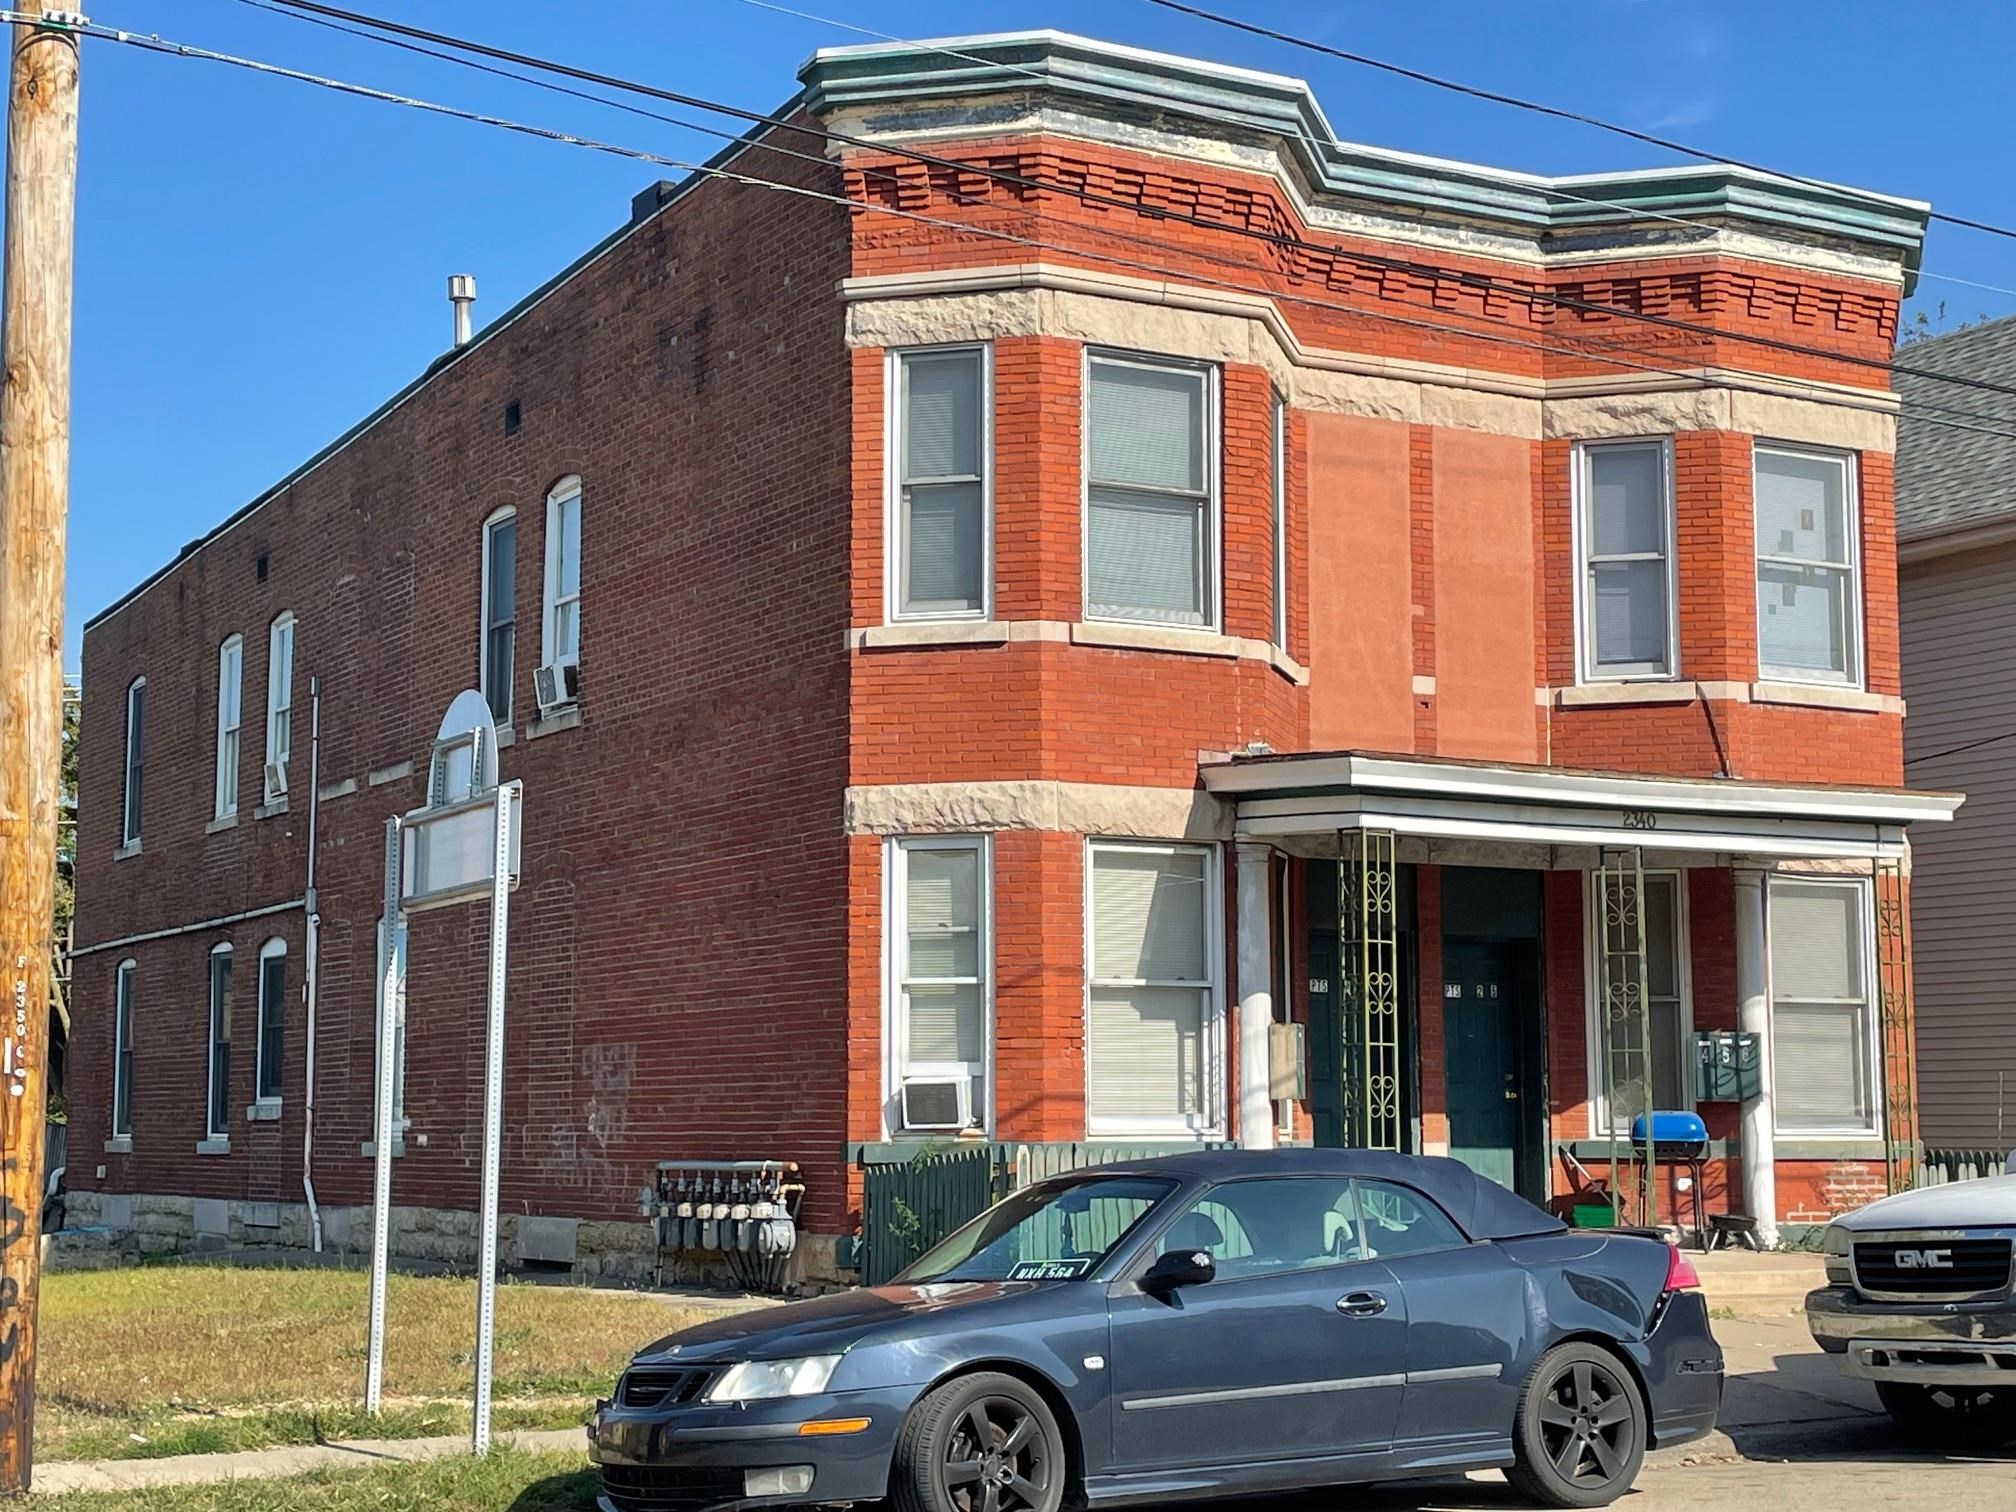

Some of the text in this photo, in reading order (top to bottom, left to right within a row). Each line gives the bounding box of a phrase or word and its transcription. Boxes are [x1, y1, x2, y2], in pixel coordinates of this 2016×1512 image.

[1623, 811, 1656, 828] 2340
[1702, 1047, 1709, 1063] 4
[1722, 1046, 1730, 1063] 5
[1895, 1249, 1954, 1268] GMC
